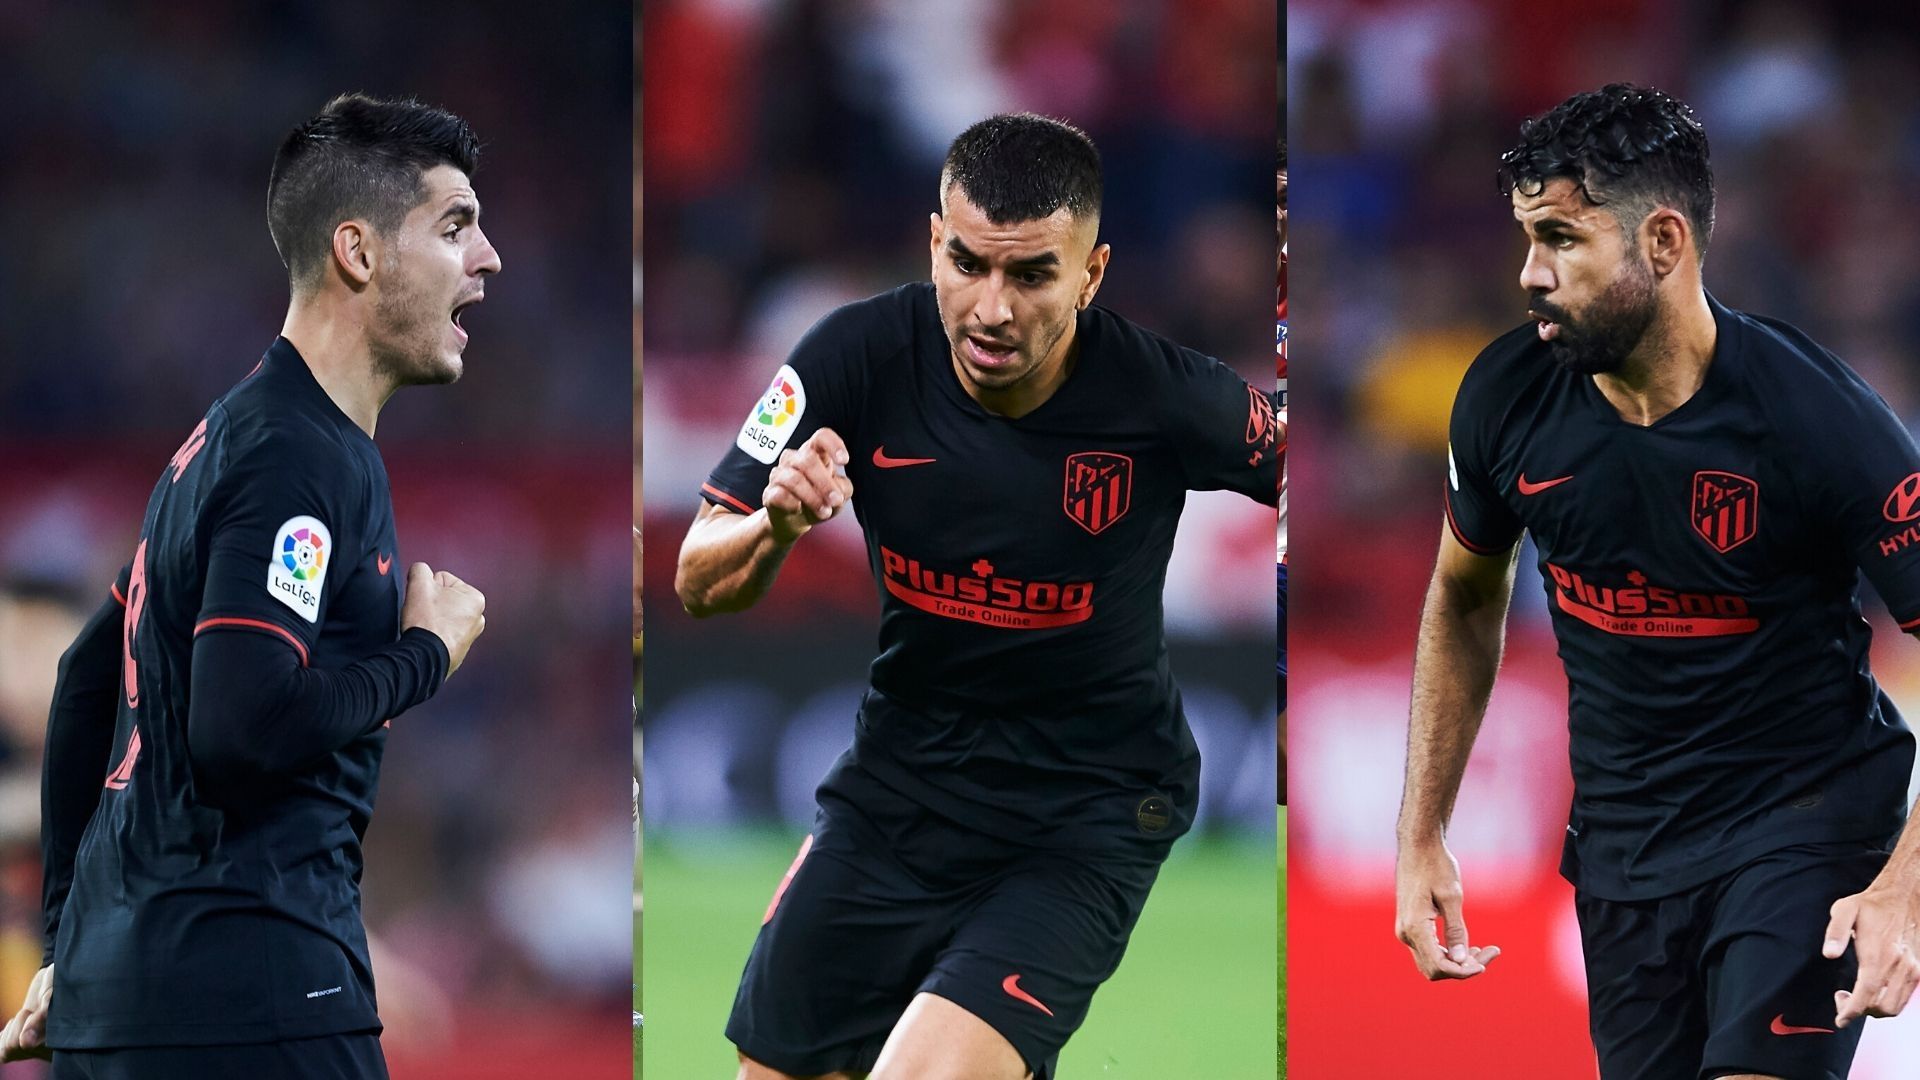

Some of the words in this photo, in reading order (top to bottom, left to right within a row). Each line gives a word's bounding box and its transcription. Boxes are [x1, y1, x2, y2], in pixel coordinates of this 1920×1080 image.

[275, 576, 316, 607] LaLiga
[881, 546, 1094, 611] Plus500
[1547, 562, 1748, 616] Plus500
[934, 600, 975, 618] Trade
[981, 610, 1031, 627] Online
[1599, 616, 1638, 632] Trade
[1644, 621, 1693, 633] Online
